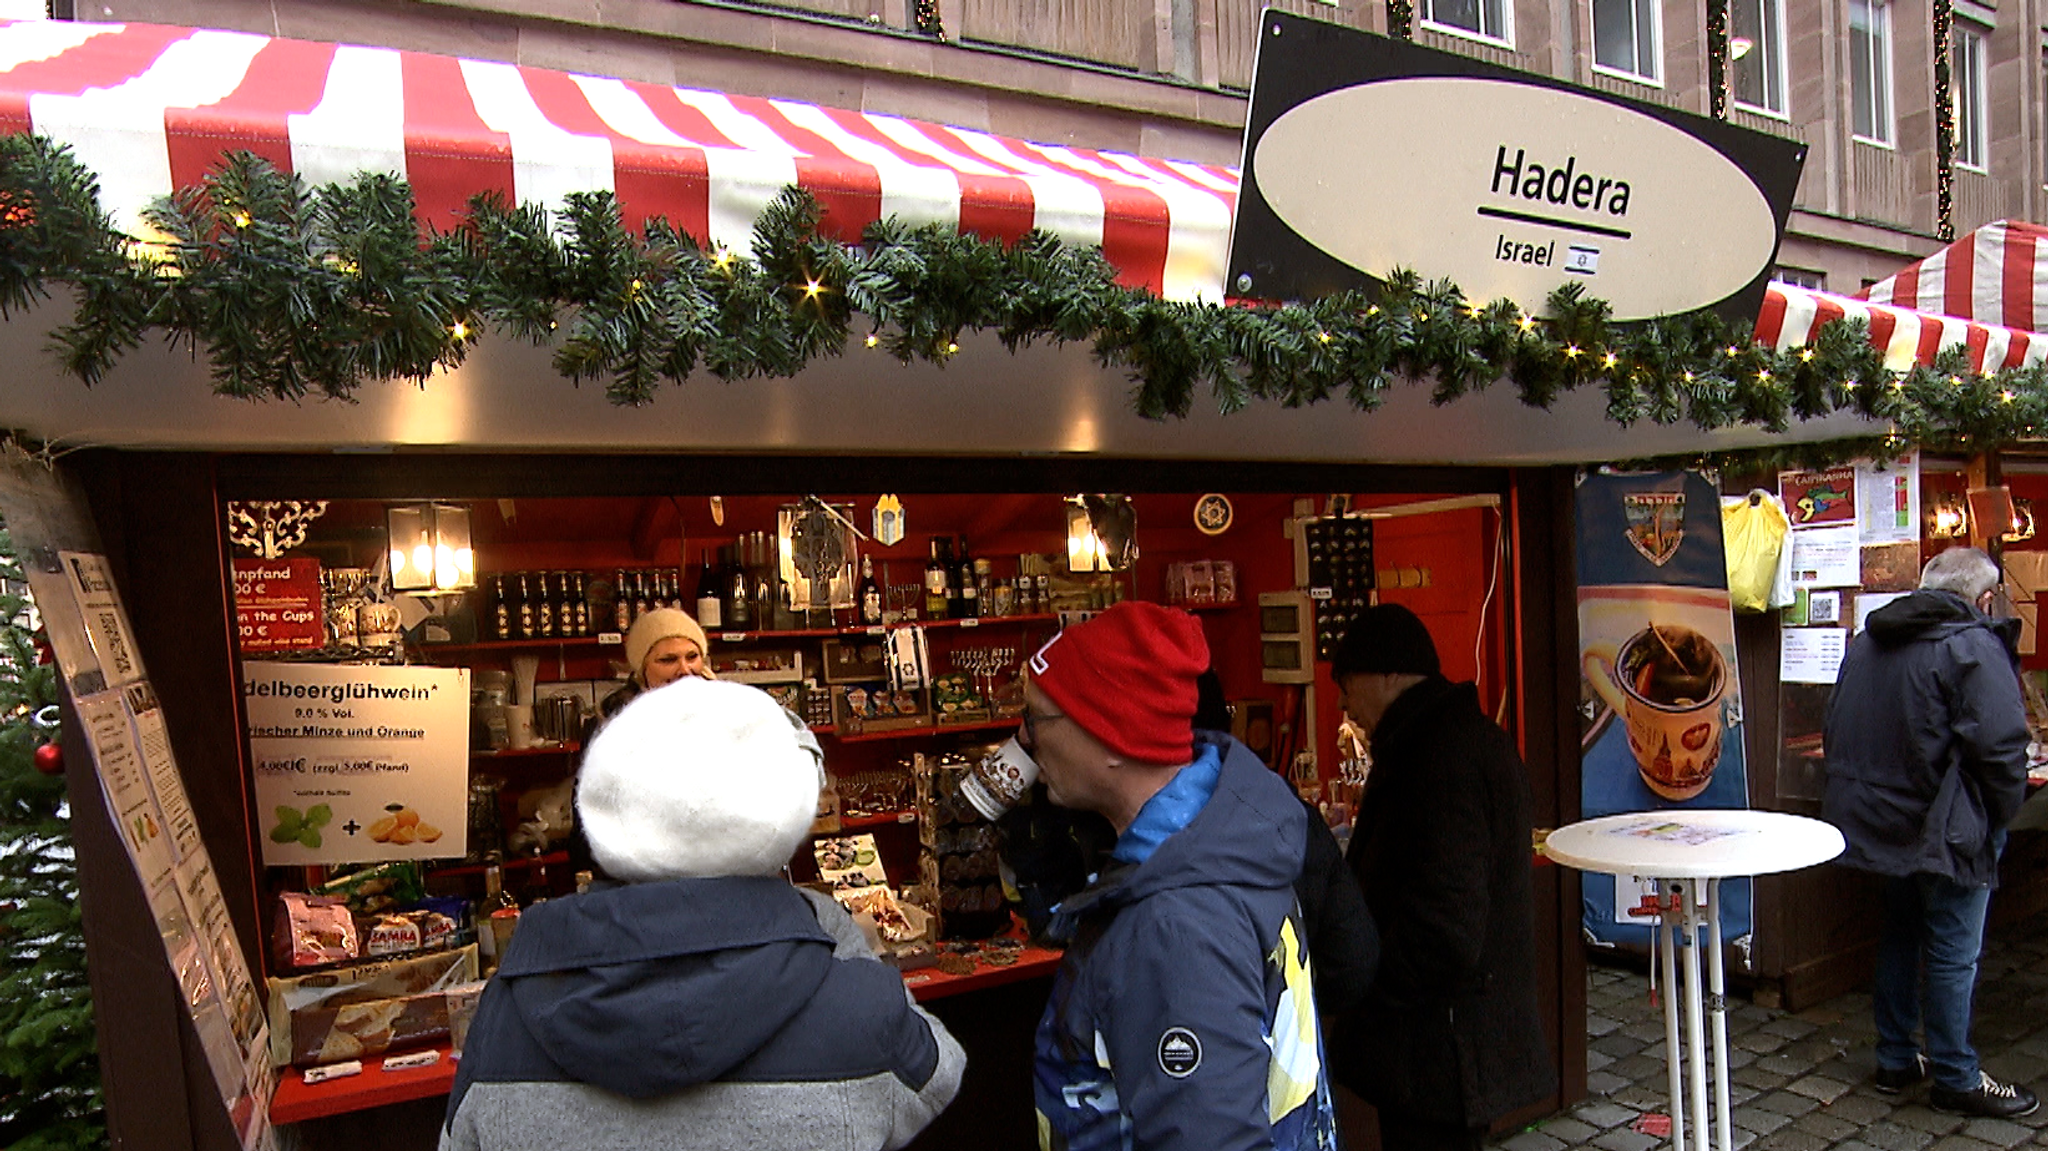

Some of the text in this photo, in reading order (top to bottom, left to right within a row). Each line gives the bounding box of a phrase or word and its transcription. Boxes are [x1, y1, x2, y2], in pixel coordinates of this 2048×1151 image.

[1491, 145, 1630, 215] Hadera
[1495, 234, 1555, 266] Israel
[254, 611, 277, 621] the
[282, 610, 315, 623] Cups
[332, 708, 355, 718] Vol.
[303, 725, 344, 737] Minze
[347, 725, 373, 737] und
[377, 725, 425, 739] Orange
